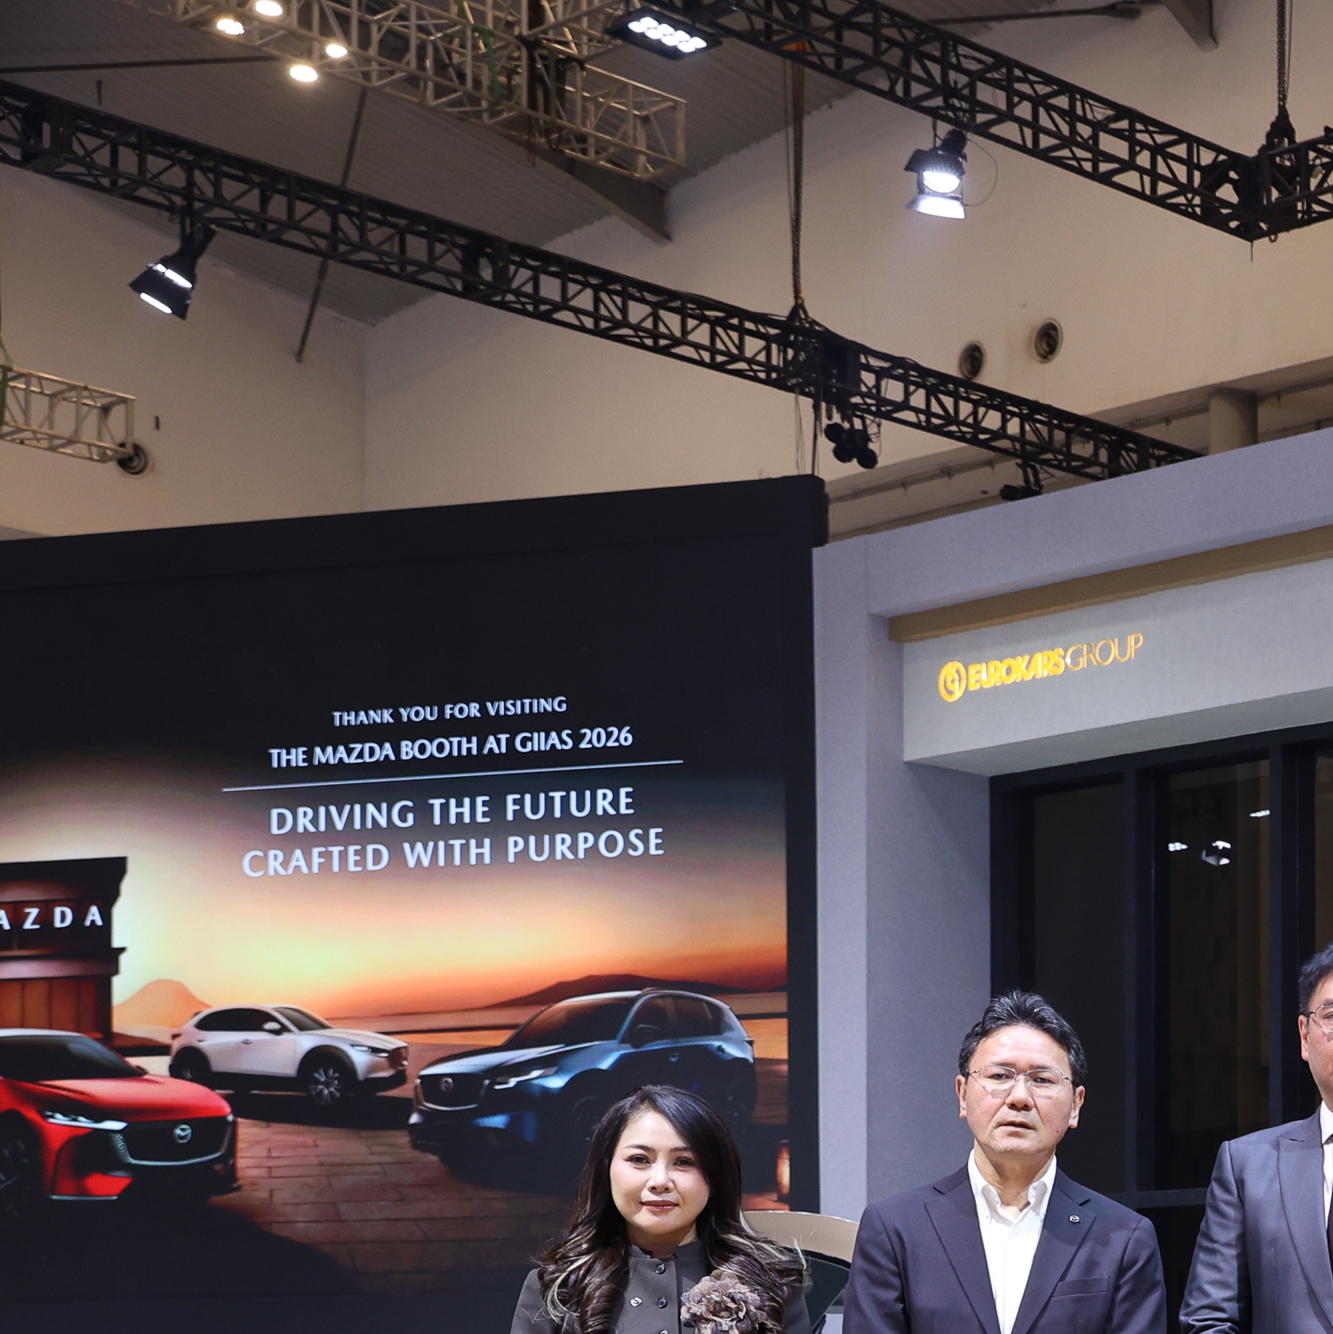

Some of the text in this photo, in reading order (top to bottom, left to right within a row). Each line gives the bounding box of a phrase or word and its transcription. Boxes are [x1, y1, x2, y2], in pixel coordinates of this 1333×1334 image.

[332, 696, 567, 727] THANK YOU FOR VISITING
[268, 726, 633, 768] THE MAZDA BOOTH AT GIIAS 2026
[269, 787, 635, 835] DRIVING THE FUTURE
[242, 828, 665, 878] CRAFTED WITH PURPOSE
